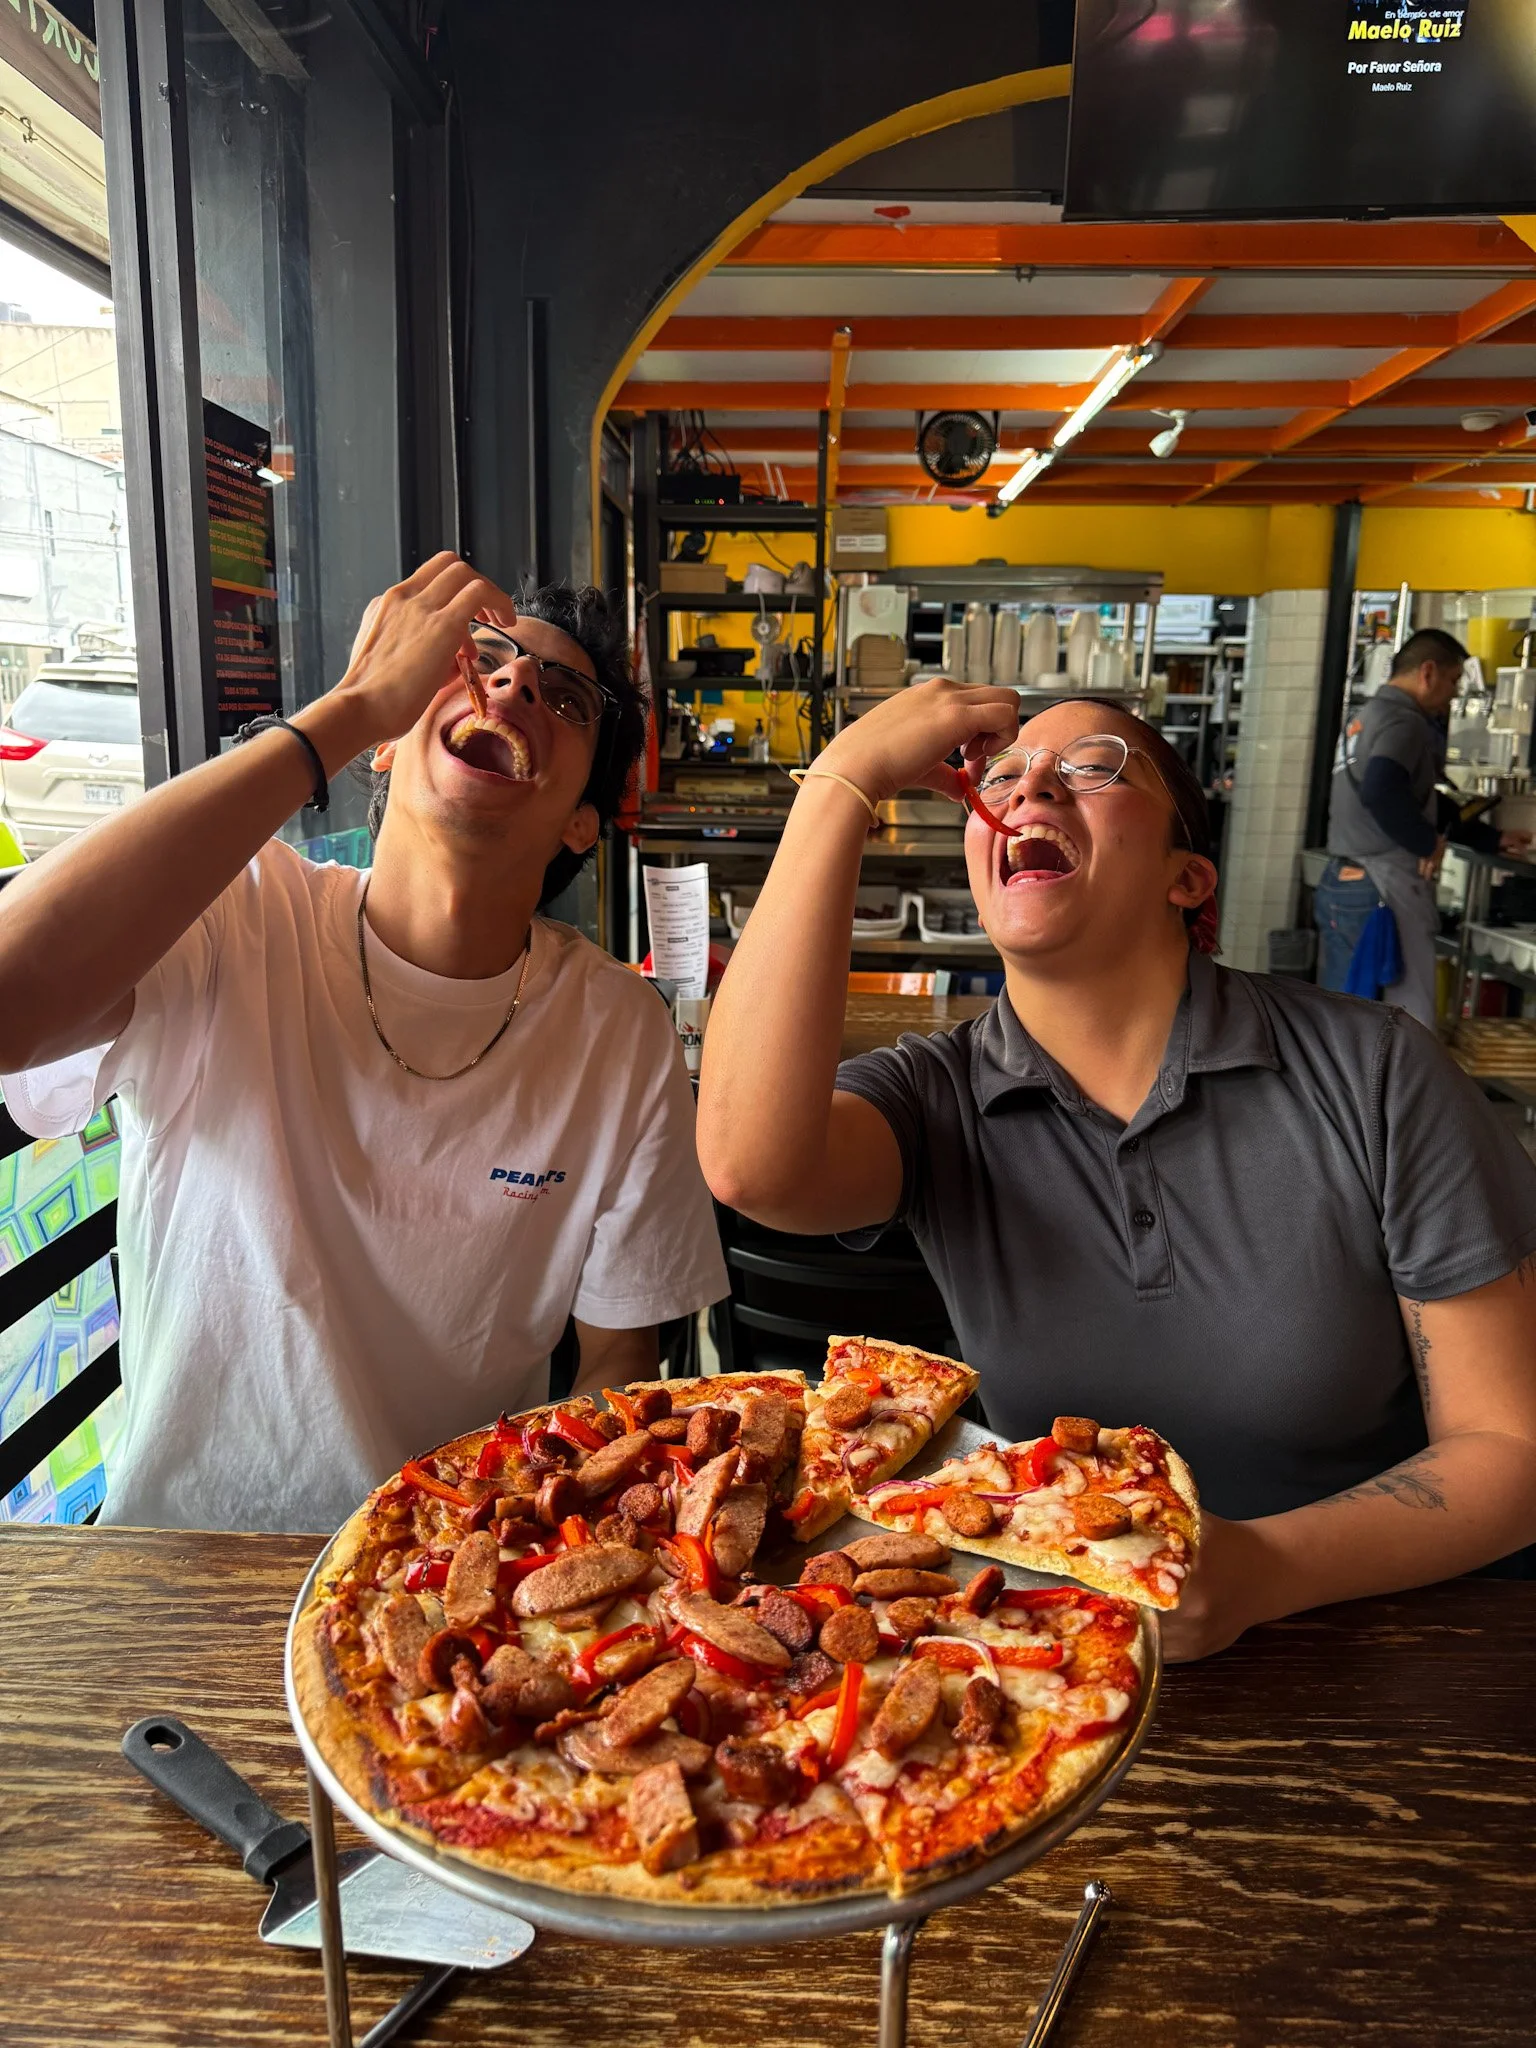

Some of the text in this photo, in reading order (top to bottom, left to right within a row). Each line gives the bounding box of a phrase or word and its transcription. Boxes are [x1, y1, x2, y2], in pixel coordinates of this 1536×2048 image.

[1385, 9, 1465, 20] En tiempo de amor
[1348, 18, 1462, 40] Maelo Ruiz
[1347, 60, 1442, 74] Por Favor Señora
[1372, 82, 1412, 92] Maelo Ruiz
[503, 1187, 538, 1203] Racing
